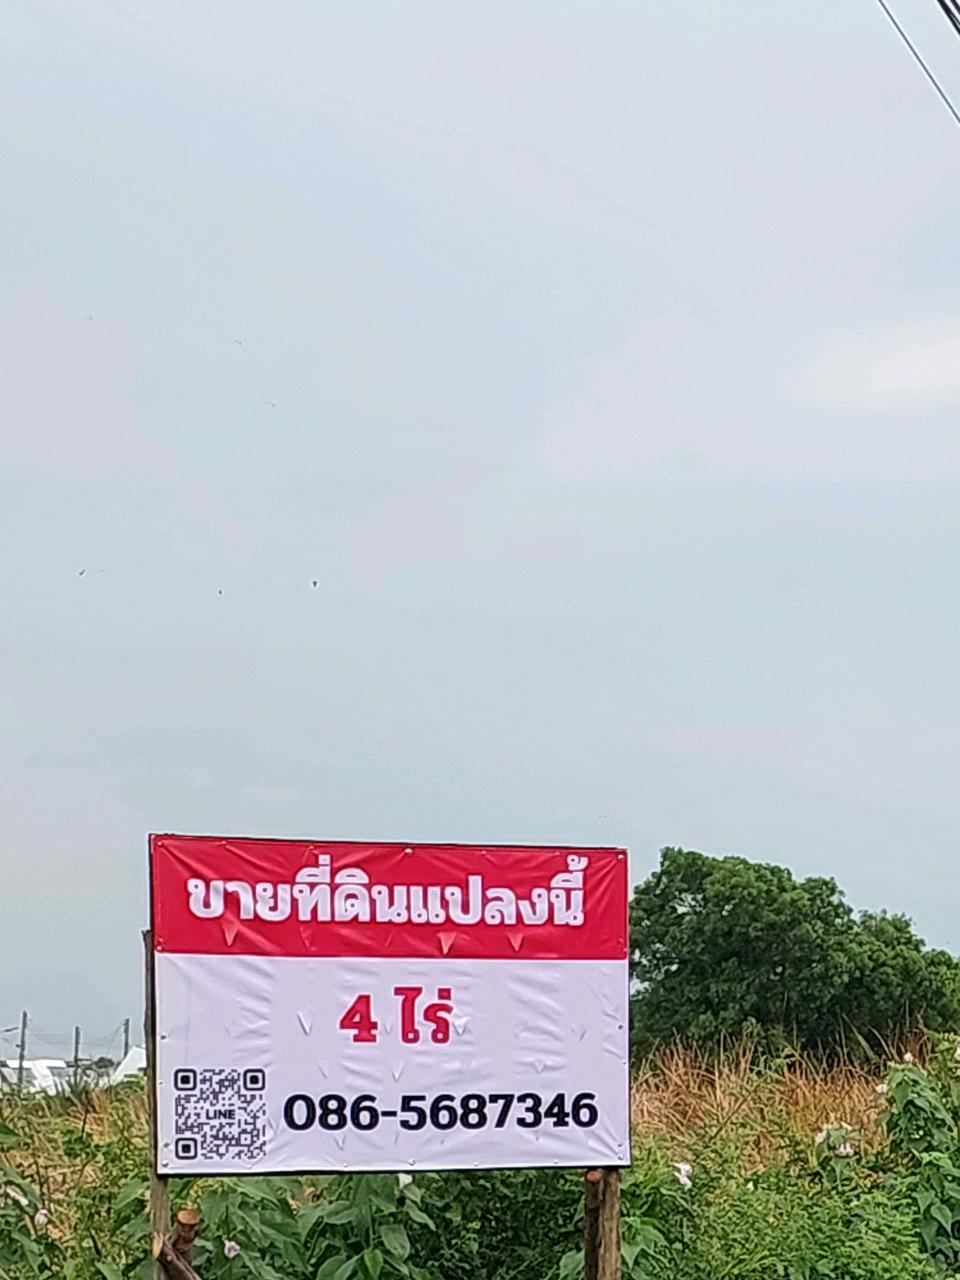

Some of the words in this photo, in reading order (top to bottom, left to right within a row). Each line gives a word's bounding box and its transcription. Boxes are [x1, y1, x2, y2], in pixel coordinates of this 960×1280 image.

[187, 854, 588, 926] ขายที่ดินแปลงนี้
[339, 994, 378, 1043] 4
[393, 986, 454, 1044] ไร่
[206, 1109, 236, 1120] LINE
[283, 1092, 598, 1130] 086-5687346
